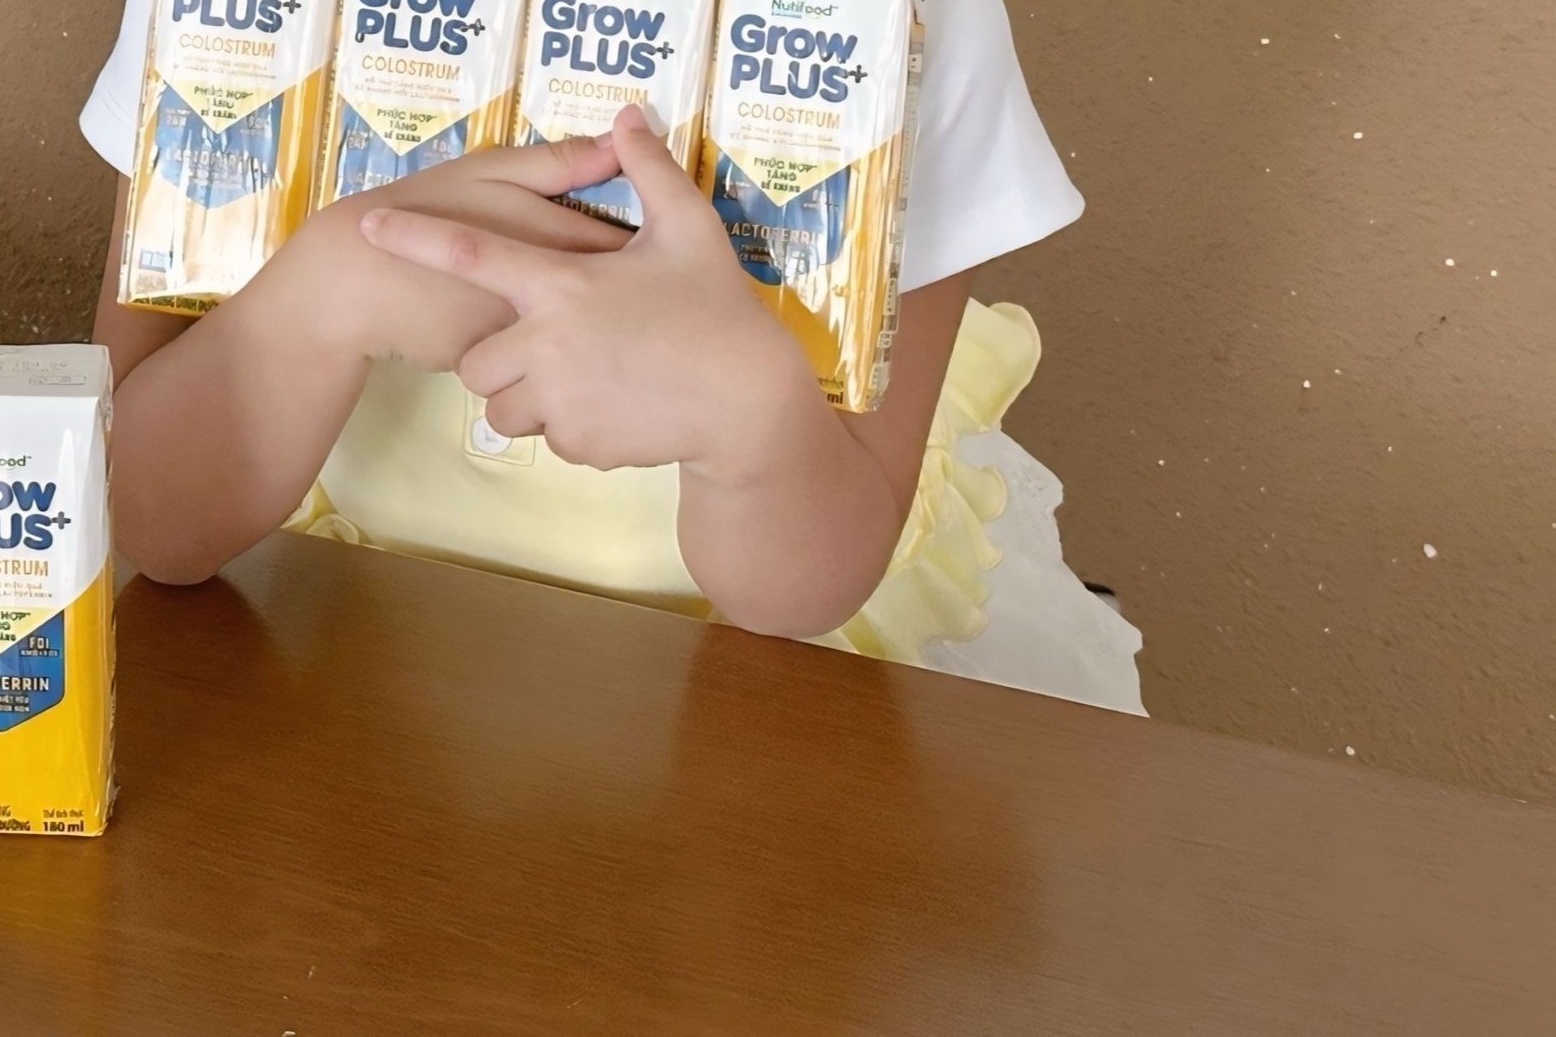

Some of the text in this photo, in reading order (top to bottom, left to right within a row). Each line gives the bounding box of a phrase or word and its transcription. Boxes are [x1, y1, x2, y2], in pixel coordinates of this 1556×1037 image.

[179, 33, 275, 59] COLOSTRUM
[730, 13, 858, 64] Grow
[362, 55, 460, 81] COLOSTRUM
[738, 101, 841, 129] COLOSTRUM
[29, 637, 49, 649] FDI
[67, 821, 84, 832] ml
